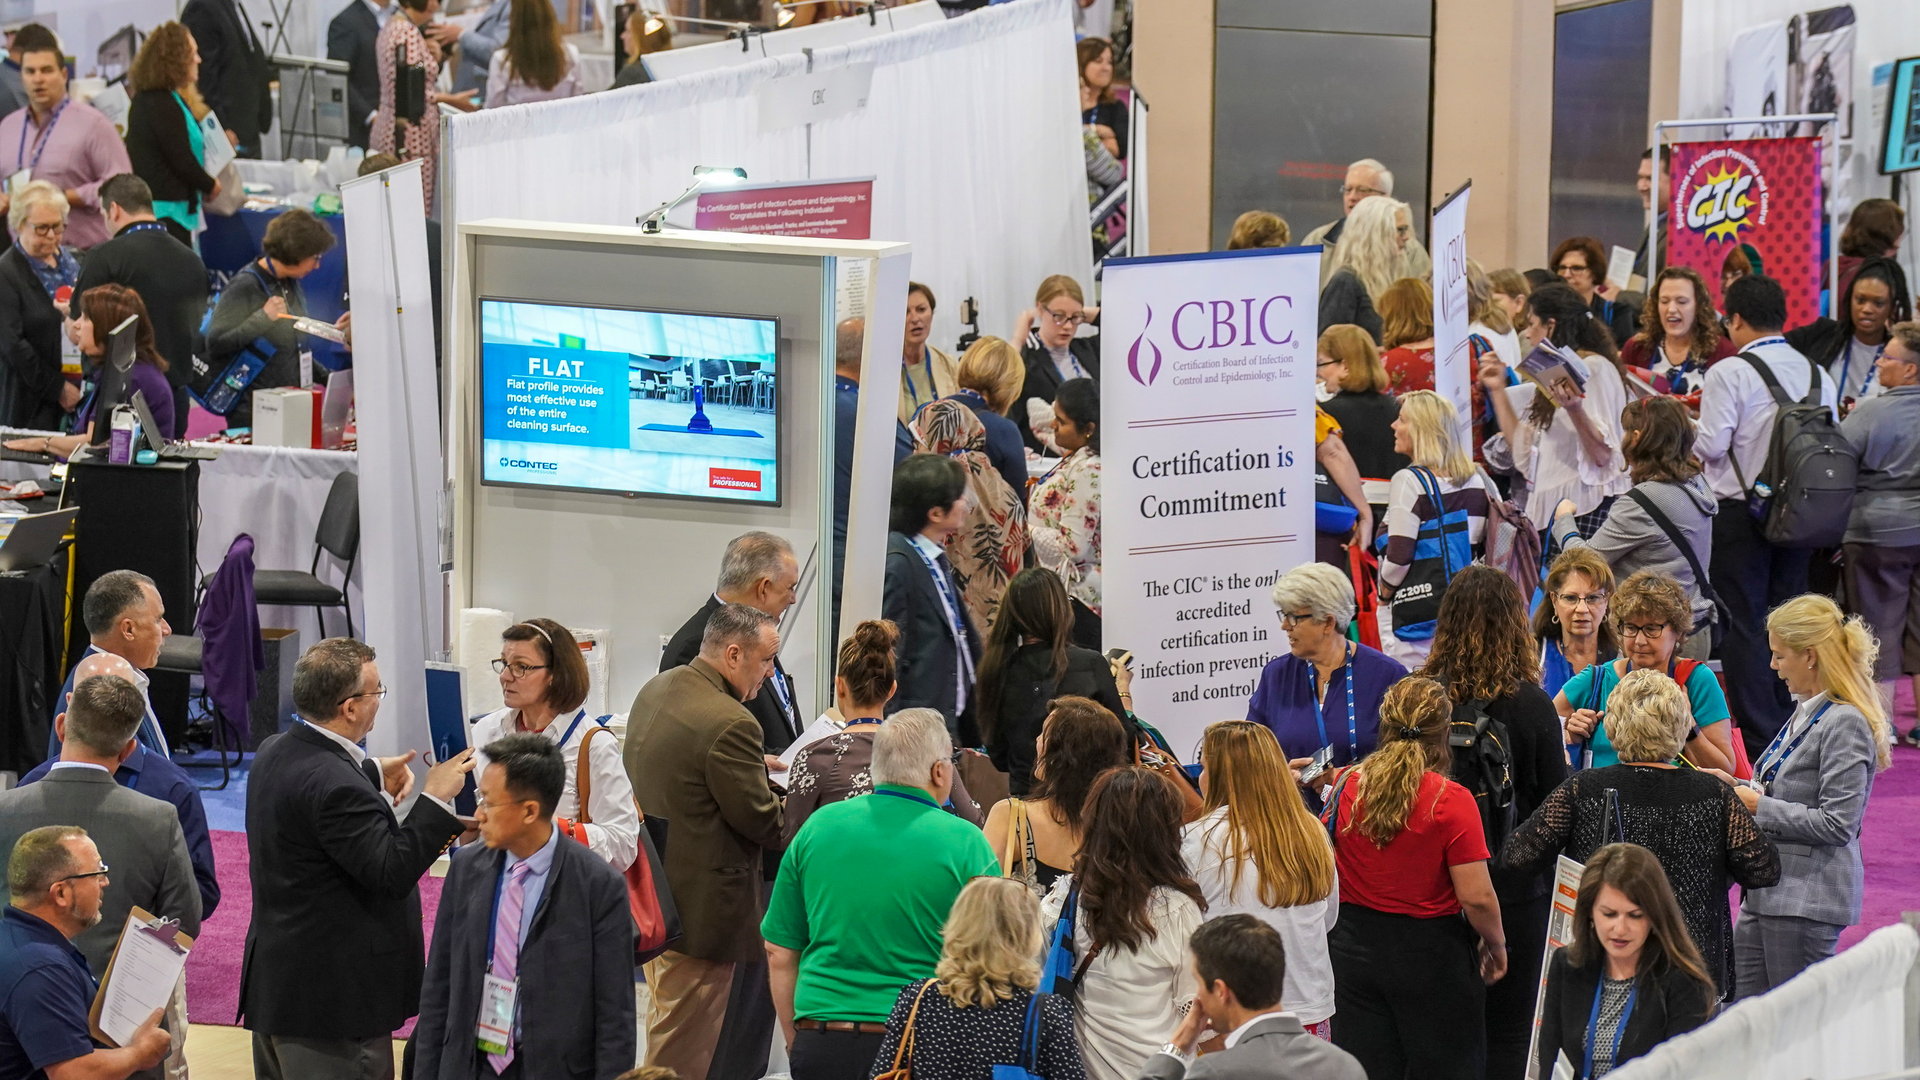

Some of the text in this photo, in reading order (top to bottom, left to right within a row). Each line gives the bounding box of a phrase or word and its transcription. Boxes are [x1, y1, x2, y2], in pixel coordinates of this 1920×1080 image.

[1694, 149, 1726, 168] Infection
[1727, 148, 1760, 176] Prevention
[1756, 174, 1768, 192] and
[707, 203, 740, 213] Certification
[740, 201, 757, 211] Board
[757, 201, 764, 209] of
[764, 199, 787, 208] Infection
[788, 198, 808, 207] Control
[808, 197, 819, 205] and
[1675, 175, 1691, 229] Superheroes
[1686, 174, 1754, 229] CIC
[1758, 192, 1768, 225] Control
[730, 210, 768, 221] Congratulates
[768, 210, 777, 218] the
[778, 207, 804, 217] Following
[528, 357, 585, 378] FLAT
[1172, 354, 1294, 371] Certification Board of Infection
[506, 378, 604, 395] Flat profile provides
[1172, 368, 1294, 386] Control and Epidemiology, Inc.
[506, 394, 597, 408] most effective use
[506, 405, 567, 419] of the entire
[506, 418, 590, 434] cleaning surface.
[509, 459, 558, 470] CONTEC
[1132, 444, 1294, 479] Certification is
[712, 479, 758, 489] PROFESSIONAL
[1140, 487, 1287, 519] Commitment
[1143, 580, 1170, 598] The
[1212, 575, 1224, 591] is
[1228, 573, 1251, 590] the
[1255, 569, 1283, 588] onl
[1407, 583, 1432, 596] 2019
[1176, 599, 1251, 622] accredited
[1160, 626, 1268, 650] certification in
[1140, 651, 1278, 680] infection preventi
[1172, 679, 1255, 703] and control
